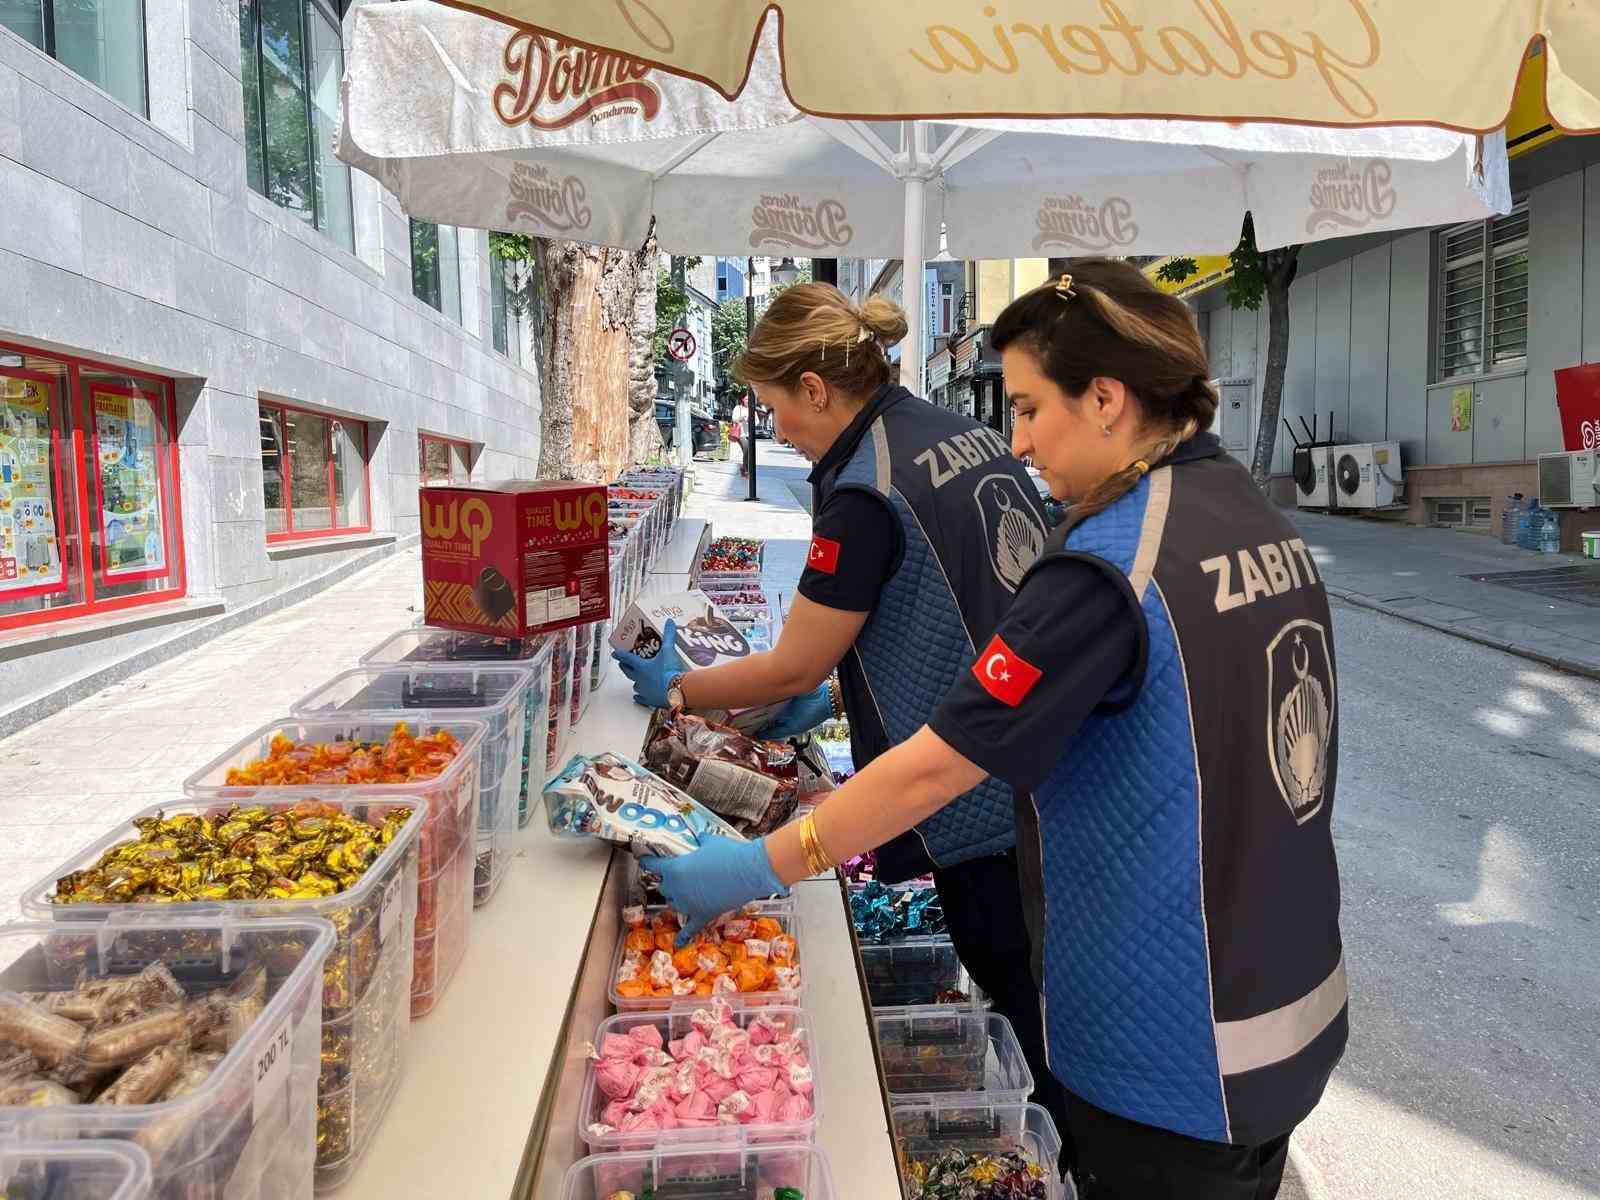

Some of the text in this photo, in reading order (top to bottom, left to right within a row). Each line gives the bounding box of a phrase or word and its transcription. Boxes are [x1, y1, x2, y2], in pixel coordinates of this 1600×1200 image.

[421, 495, 493, 558] WQ
[526, 513, 552, 529] TIME
[553, 492, 608, 539] WQ
[256, 1026, 289, 1082] 200 TL
